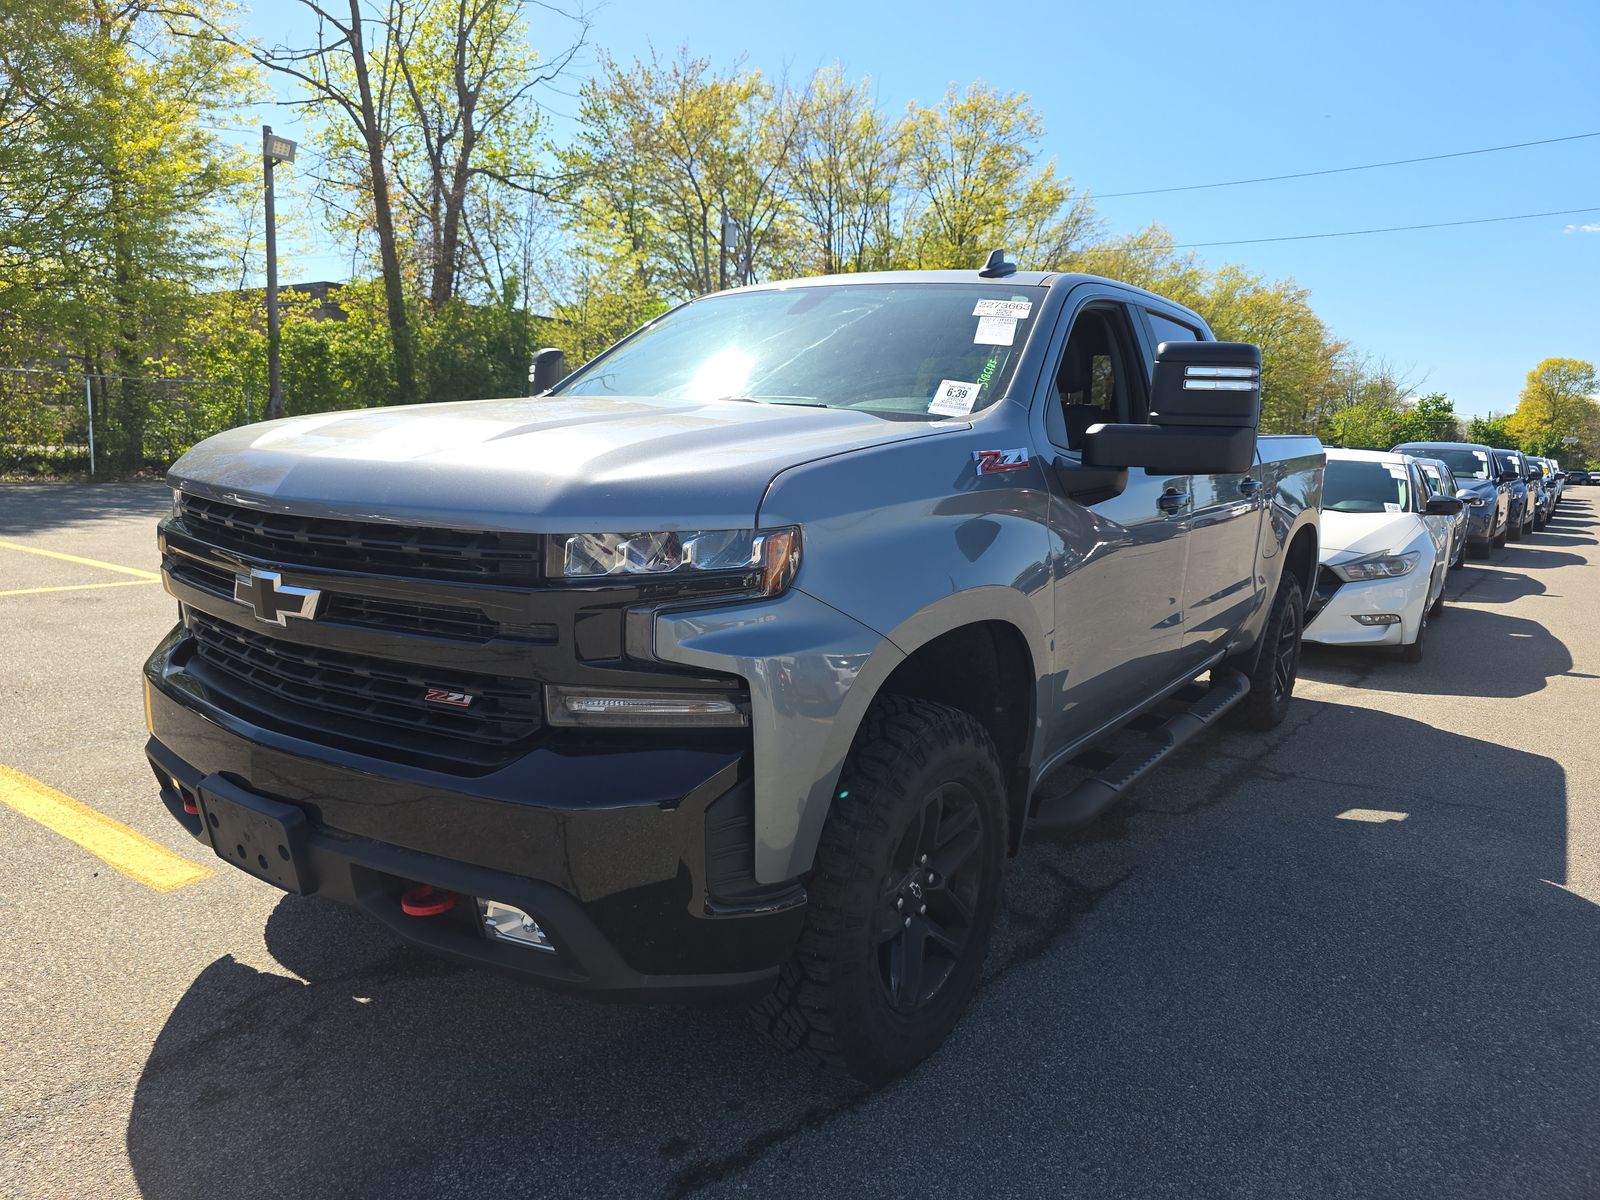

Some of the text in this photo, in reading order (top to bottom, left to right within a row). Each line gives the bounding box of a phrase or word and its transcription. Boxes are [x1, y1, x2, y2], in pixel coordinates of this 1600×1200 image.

[979, 301, 1031, 311] 2273663
[946, 388, 968, 399] 6:39
[972, 448, 1029, 476] Z71
[424, 688, 473, 707] Z71
